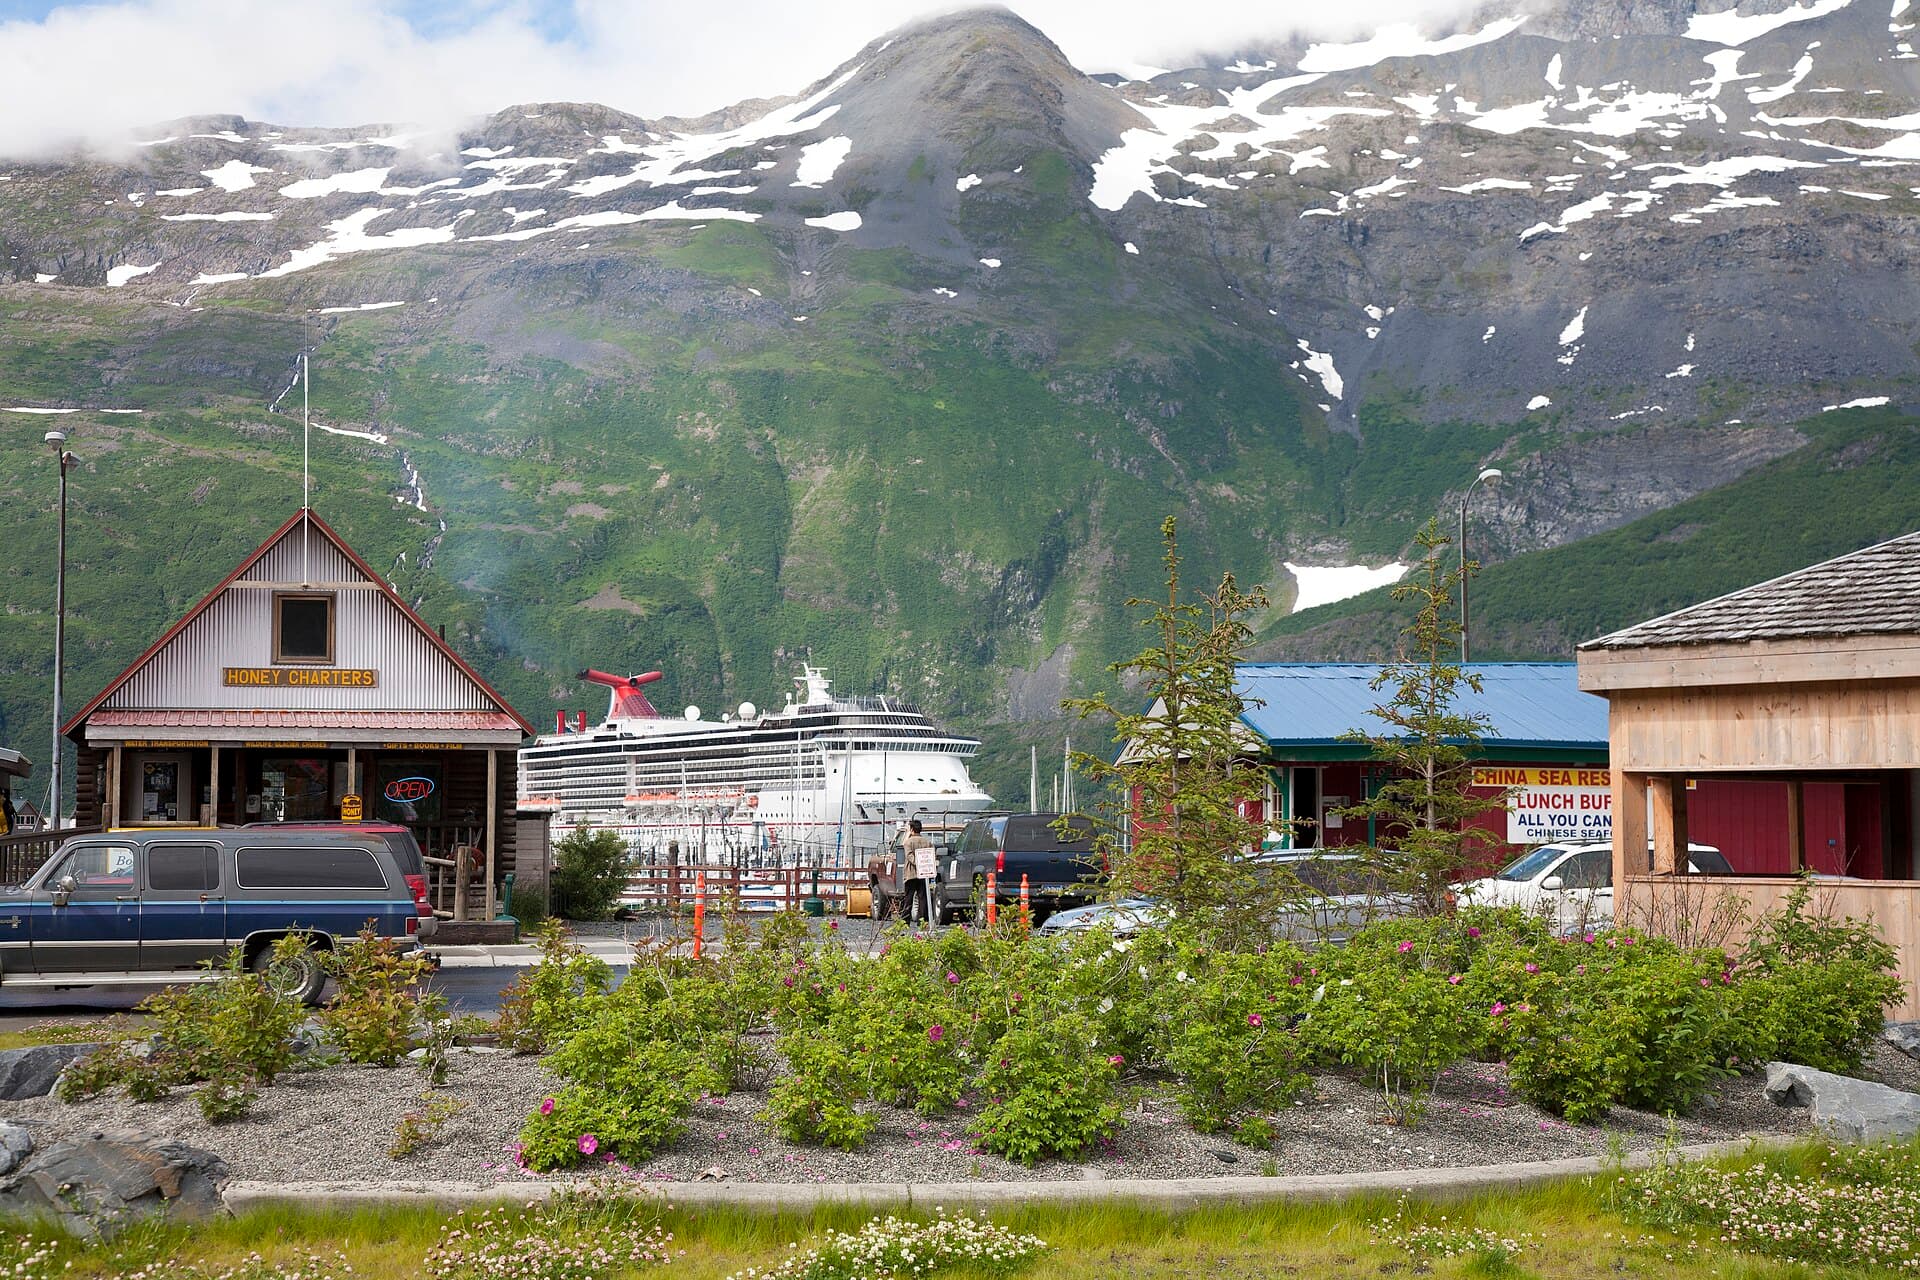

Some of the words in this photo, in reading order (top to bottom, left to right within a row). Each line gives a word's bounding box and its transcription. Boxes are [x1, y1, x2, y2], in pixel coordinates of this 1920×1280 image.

[228, 669, 281, 684] HONEY
[289, 670, 373, 686] CHARTERS
[151, 740, 209, 748] TRANSPORTATION
[1473, 769, 1528, 784] CHINA
[1539, 770, 1572, 785] SEA
[385, 781, 431, 798] OPEN
[1517, 793, 1574, 809] LUNCH
[342, 807, 361, 816] HONEY
[1518, 814, 1545, 826] ALL
[1548, 814, 1578, 827] YOU
[1582, 814, 1612, 827] CAN
[1526, 828, 1577, 837] CHINESE
